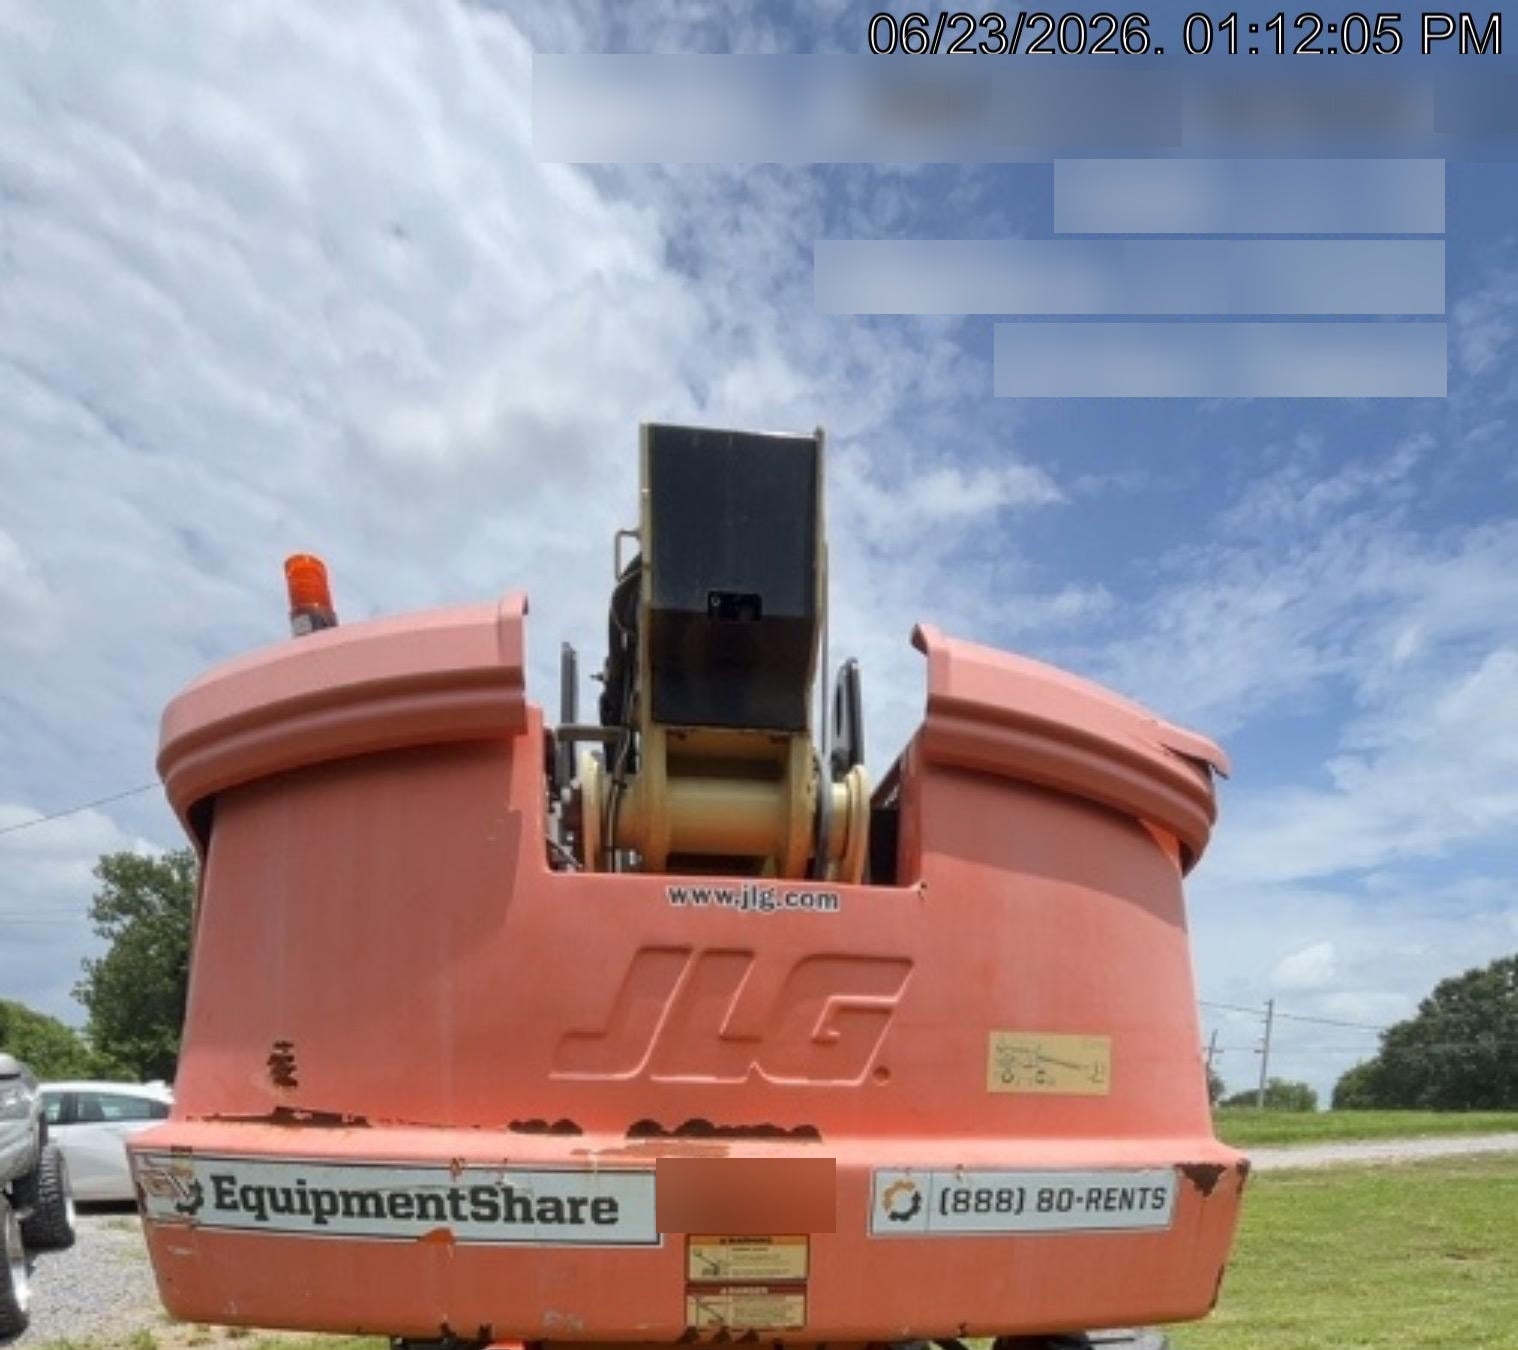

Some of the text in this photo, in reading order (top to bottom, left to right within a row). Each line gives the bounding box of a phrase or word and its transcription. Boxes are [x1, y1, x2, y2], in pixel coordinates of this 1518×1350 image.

[667, 884, 839, 911] www.jlg.com
[550, 944, 914, 1087] JLG
[210, 1174, 620, 1226] EquipmentShare
[939, 1186, 1168, 1216] (888) 80-RENTS
